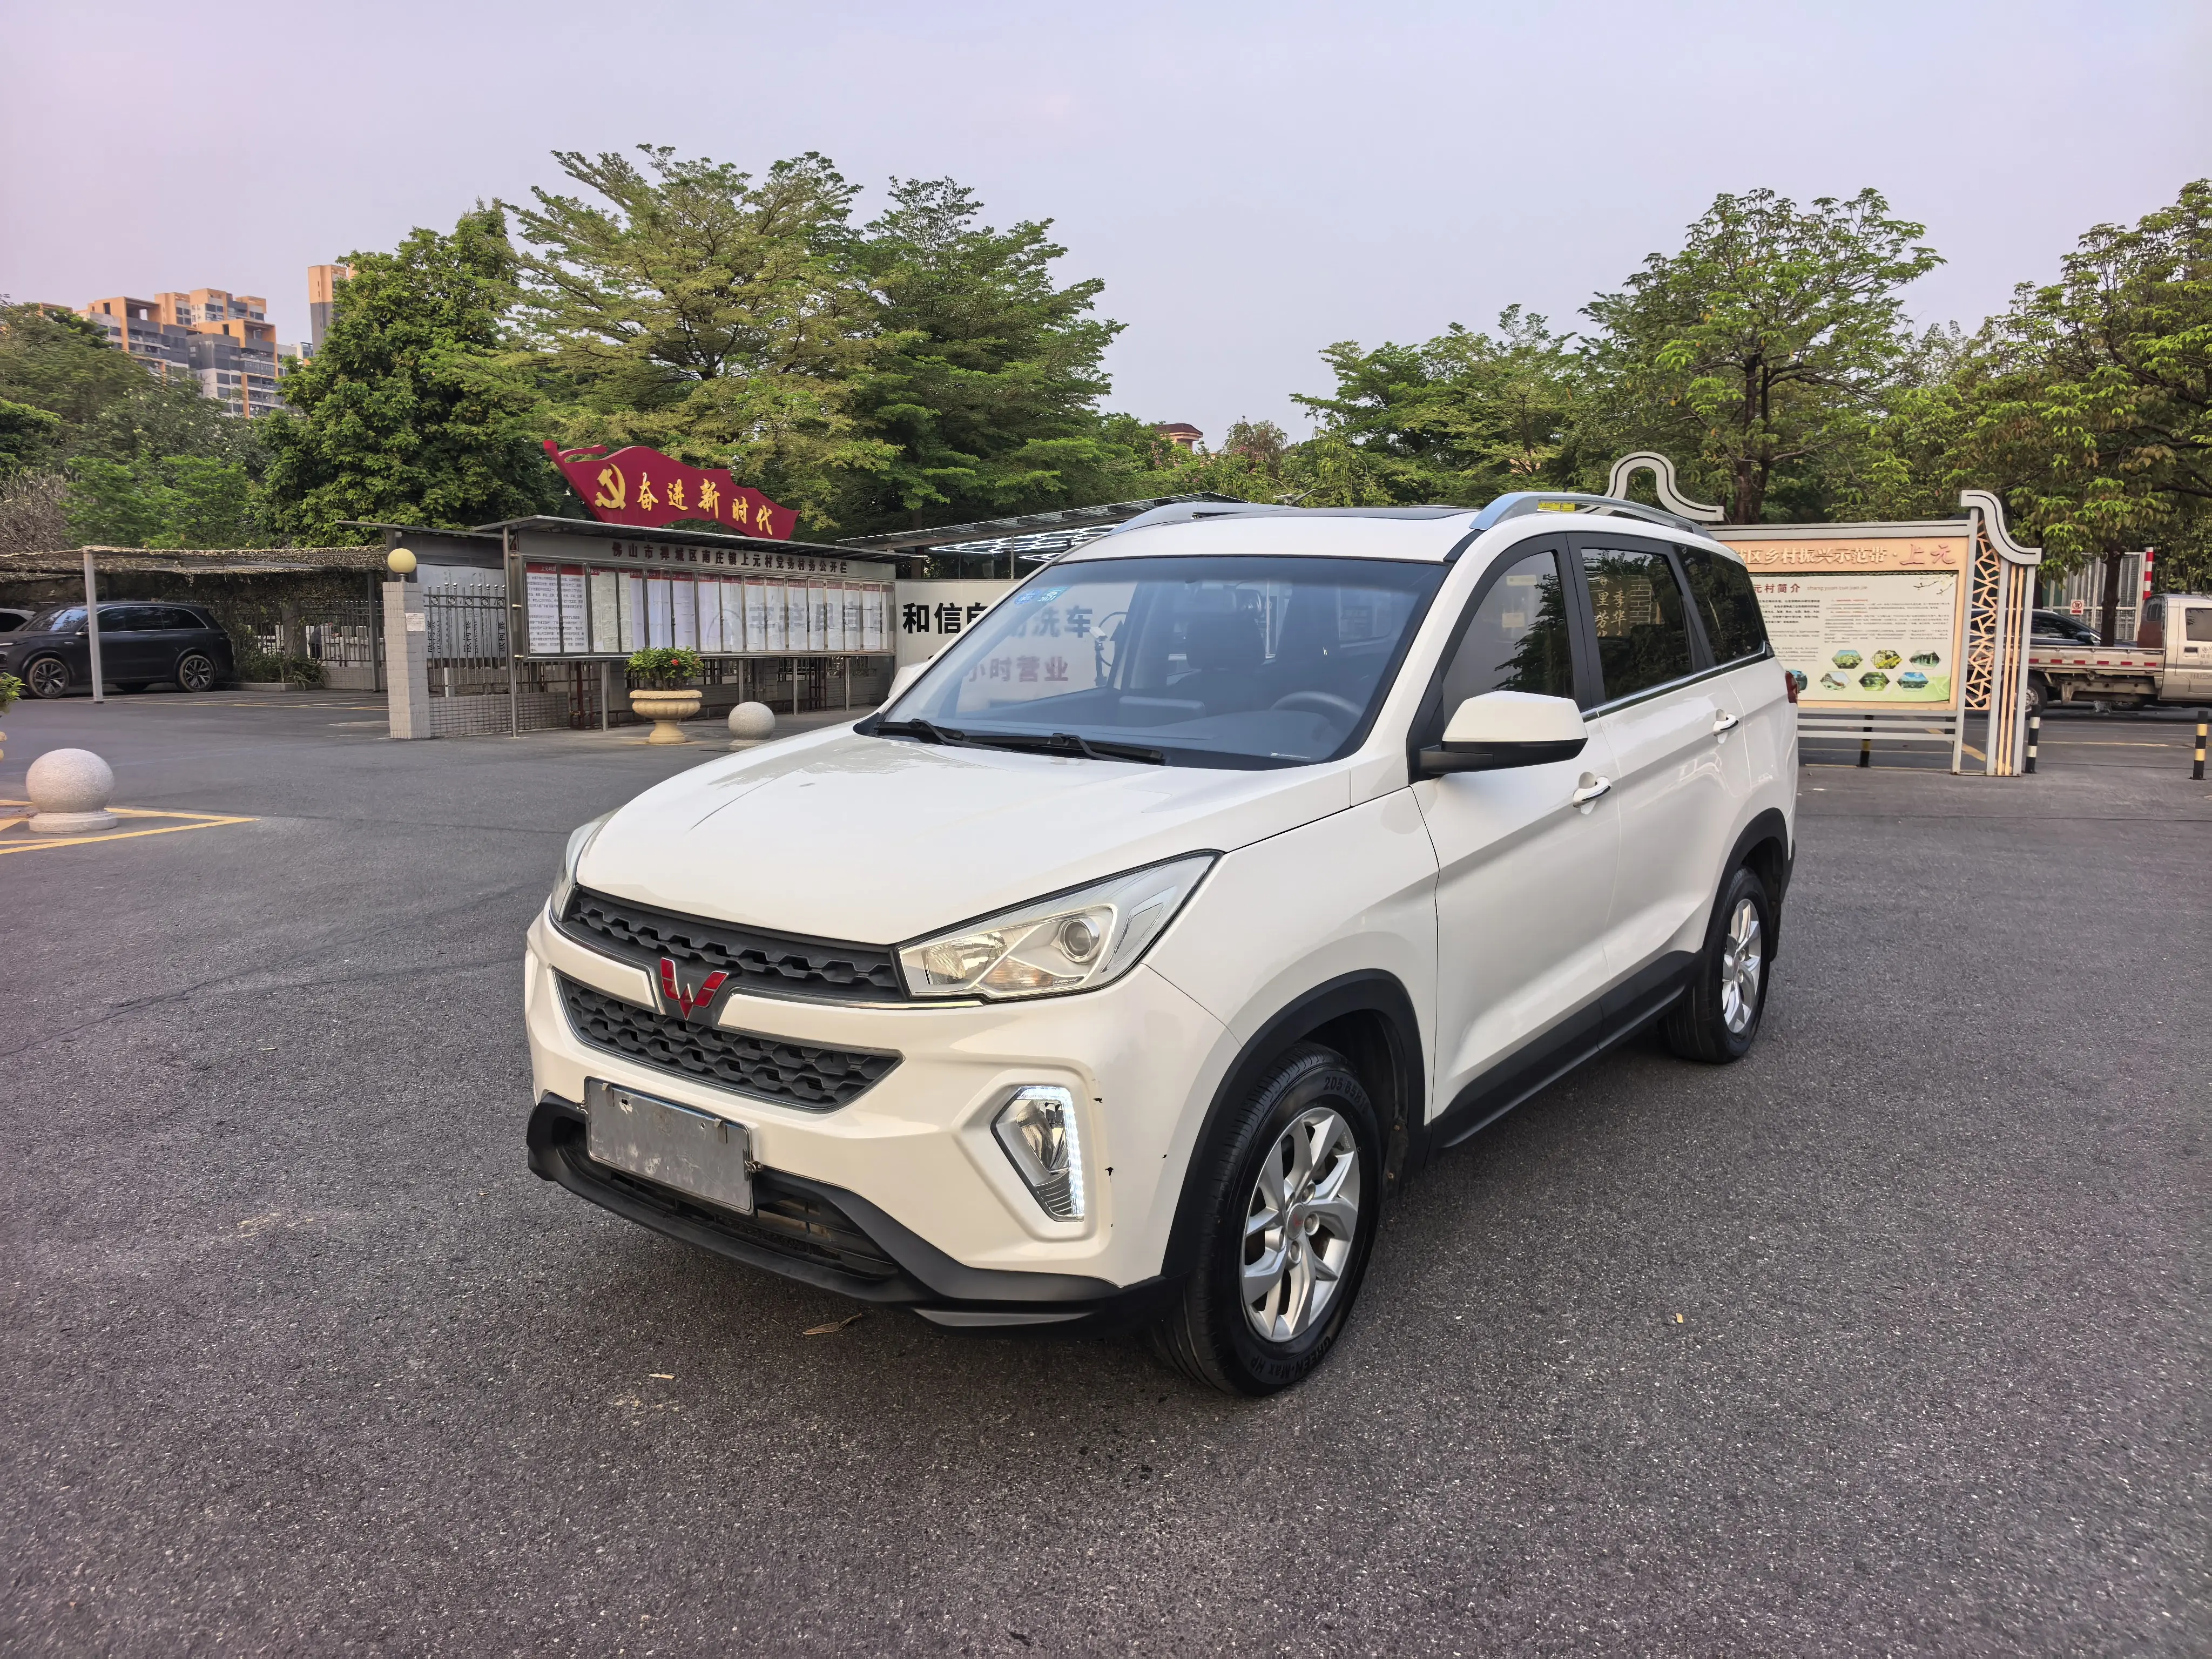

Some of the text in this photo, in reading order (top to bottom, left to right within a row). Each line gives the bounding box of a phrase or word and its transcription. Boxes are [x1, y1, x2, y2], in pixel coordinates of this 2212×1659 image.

[637, 472, 773, 536] 奋进新时代
